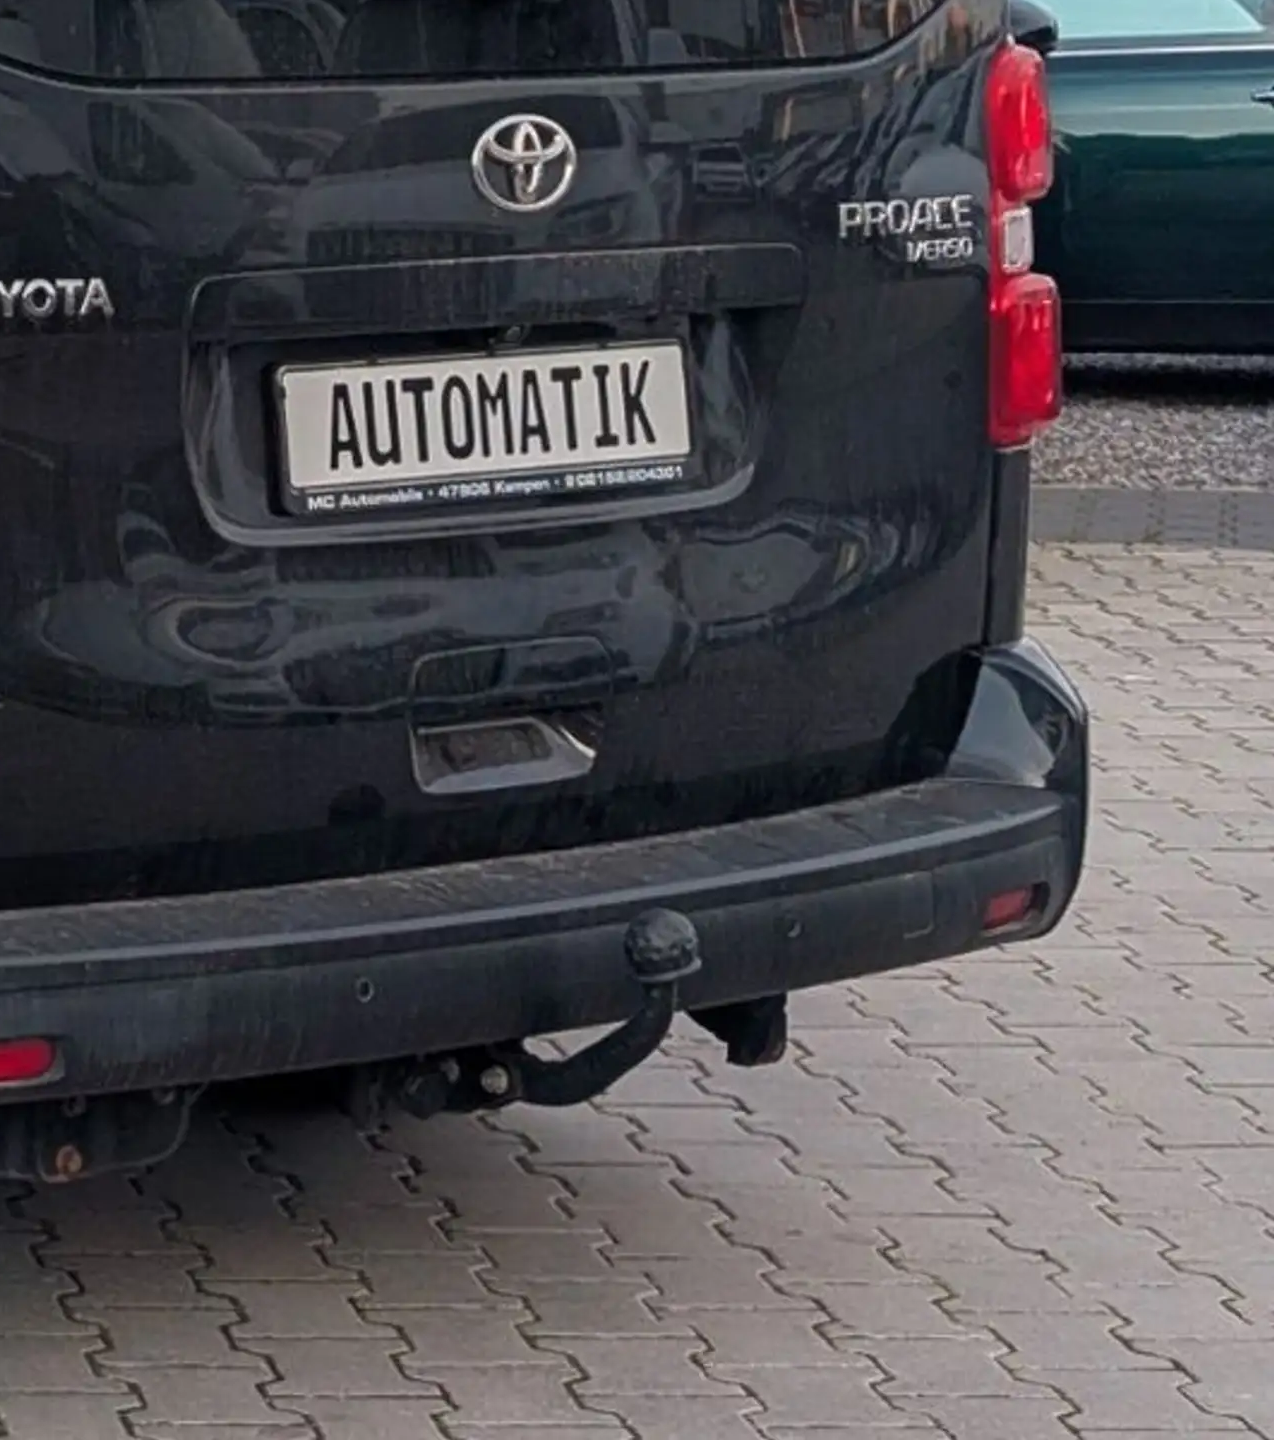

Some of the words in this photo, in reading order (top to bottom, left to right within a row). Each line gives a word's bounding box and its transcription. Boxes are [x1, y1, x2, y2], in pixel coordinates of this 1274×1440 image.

[838, 194, 974, 239] PROACE
[906, 237, 974, 263] VERSO
[329, 360, 657, 471] AUTOMATIK
[307, 494, 335, 511] MC
